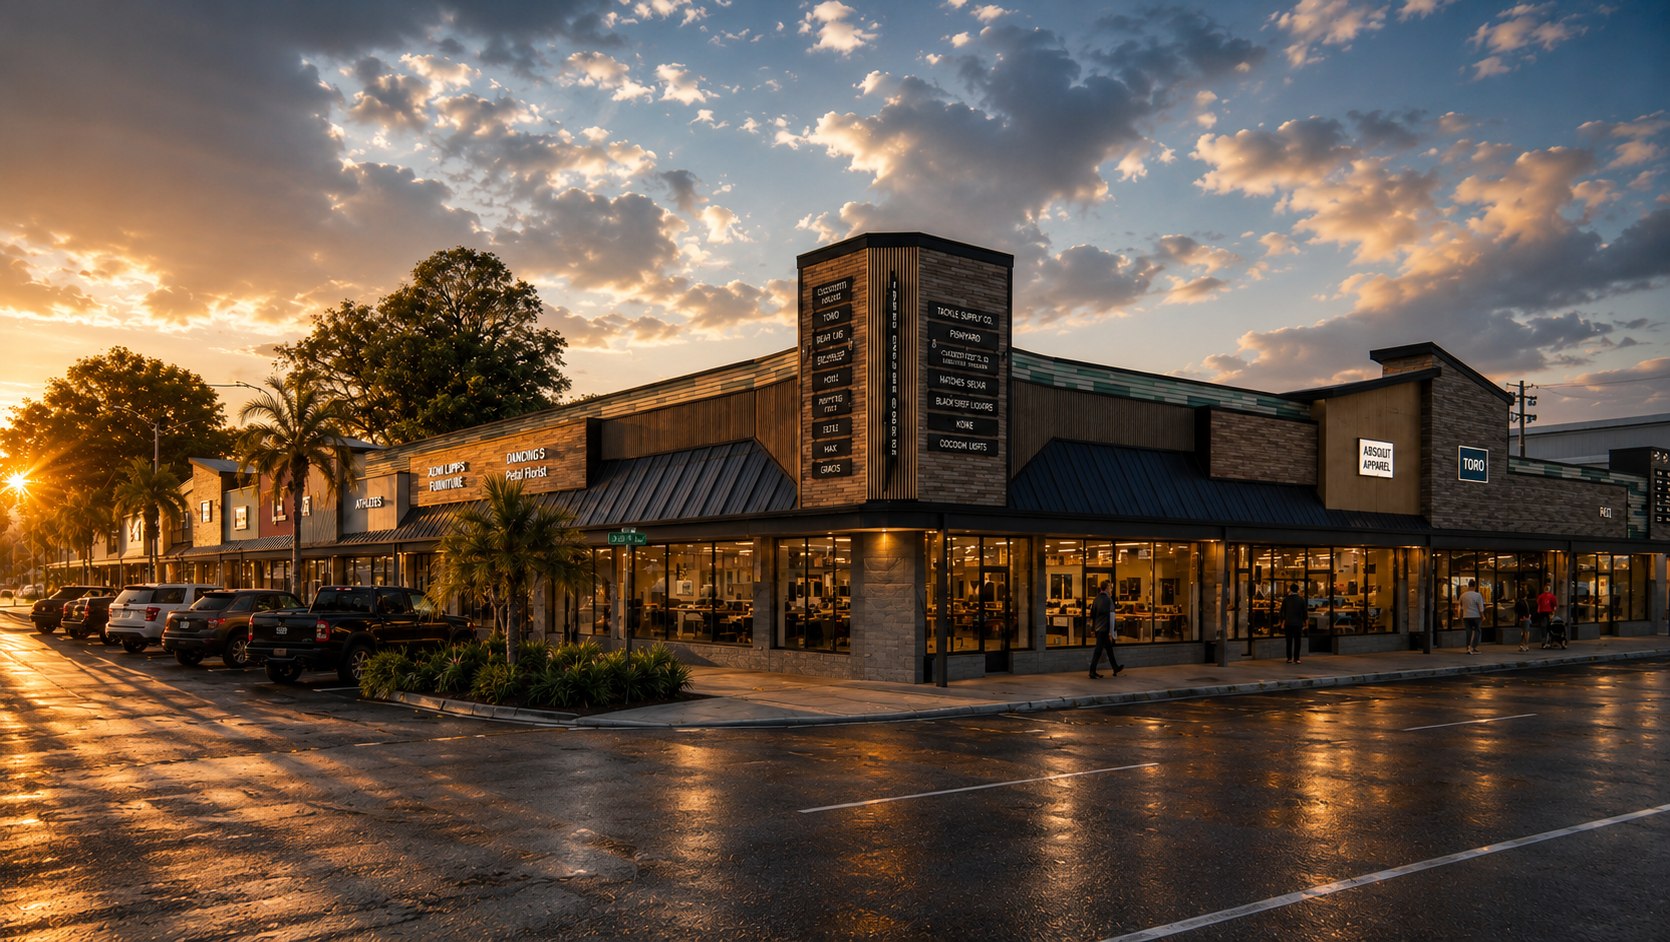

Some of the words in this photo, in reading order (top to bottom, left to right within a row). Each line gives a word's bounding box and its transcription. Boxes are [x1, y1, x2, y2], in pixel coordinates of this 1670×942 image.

[1363, 460, 1391, 472] APPAREL
[1463, 457, 1485, 472] TORO
[524, 465, 547, 479] Florist
